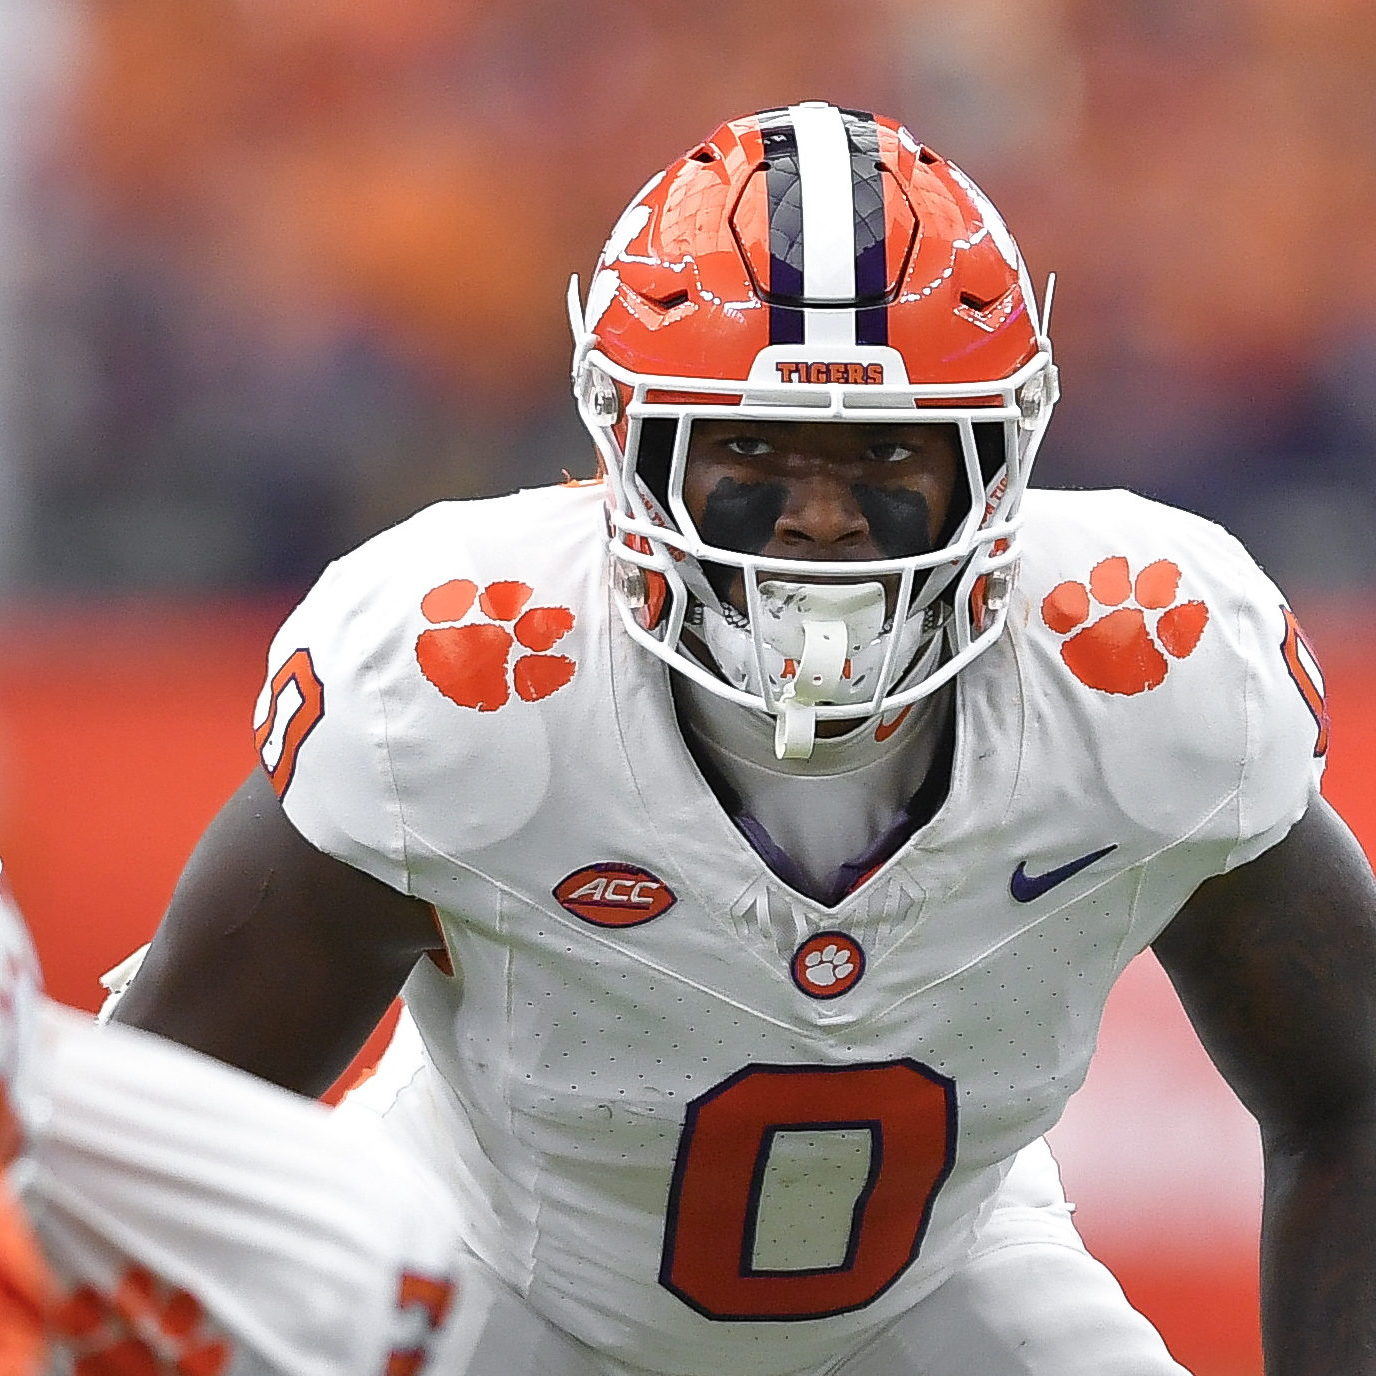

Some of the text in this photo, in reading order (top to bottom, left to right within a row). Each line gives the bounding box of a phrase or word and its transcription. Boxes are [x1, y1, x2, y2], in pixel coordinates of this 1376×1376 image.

[776, 362, 884, 385] TIGERS
[567, 877, 661, 905] ACC
[658, 1057, 959, 1322] 0
